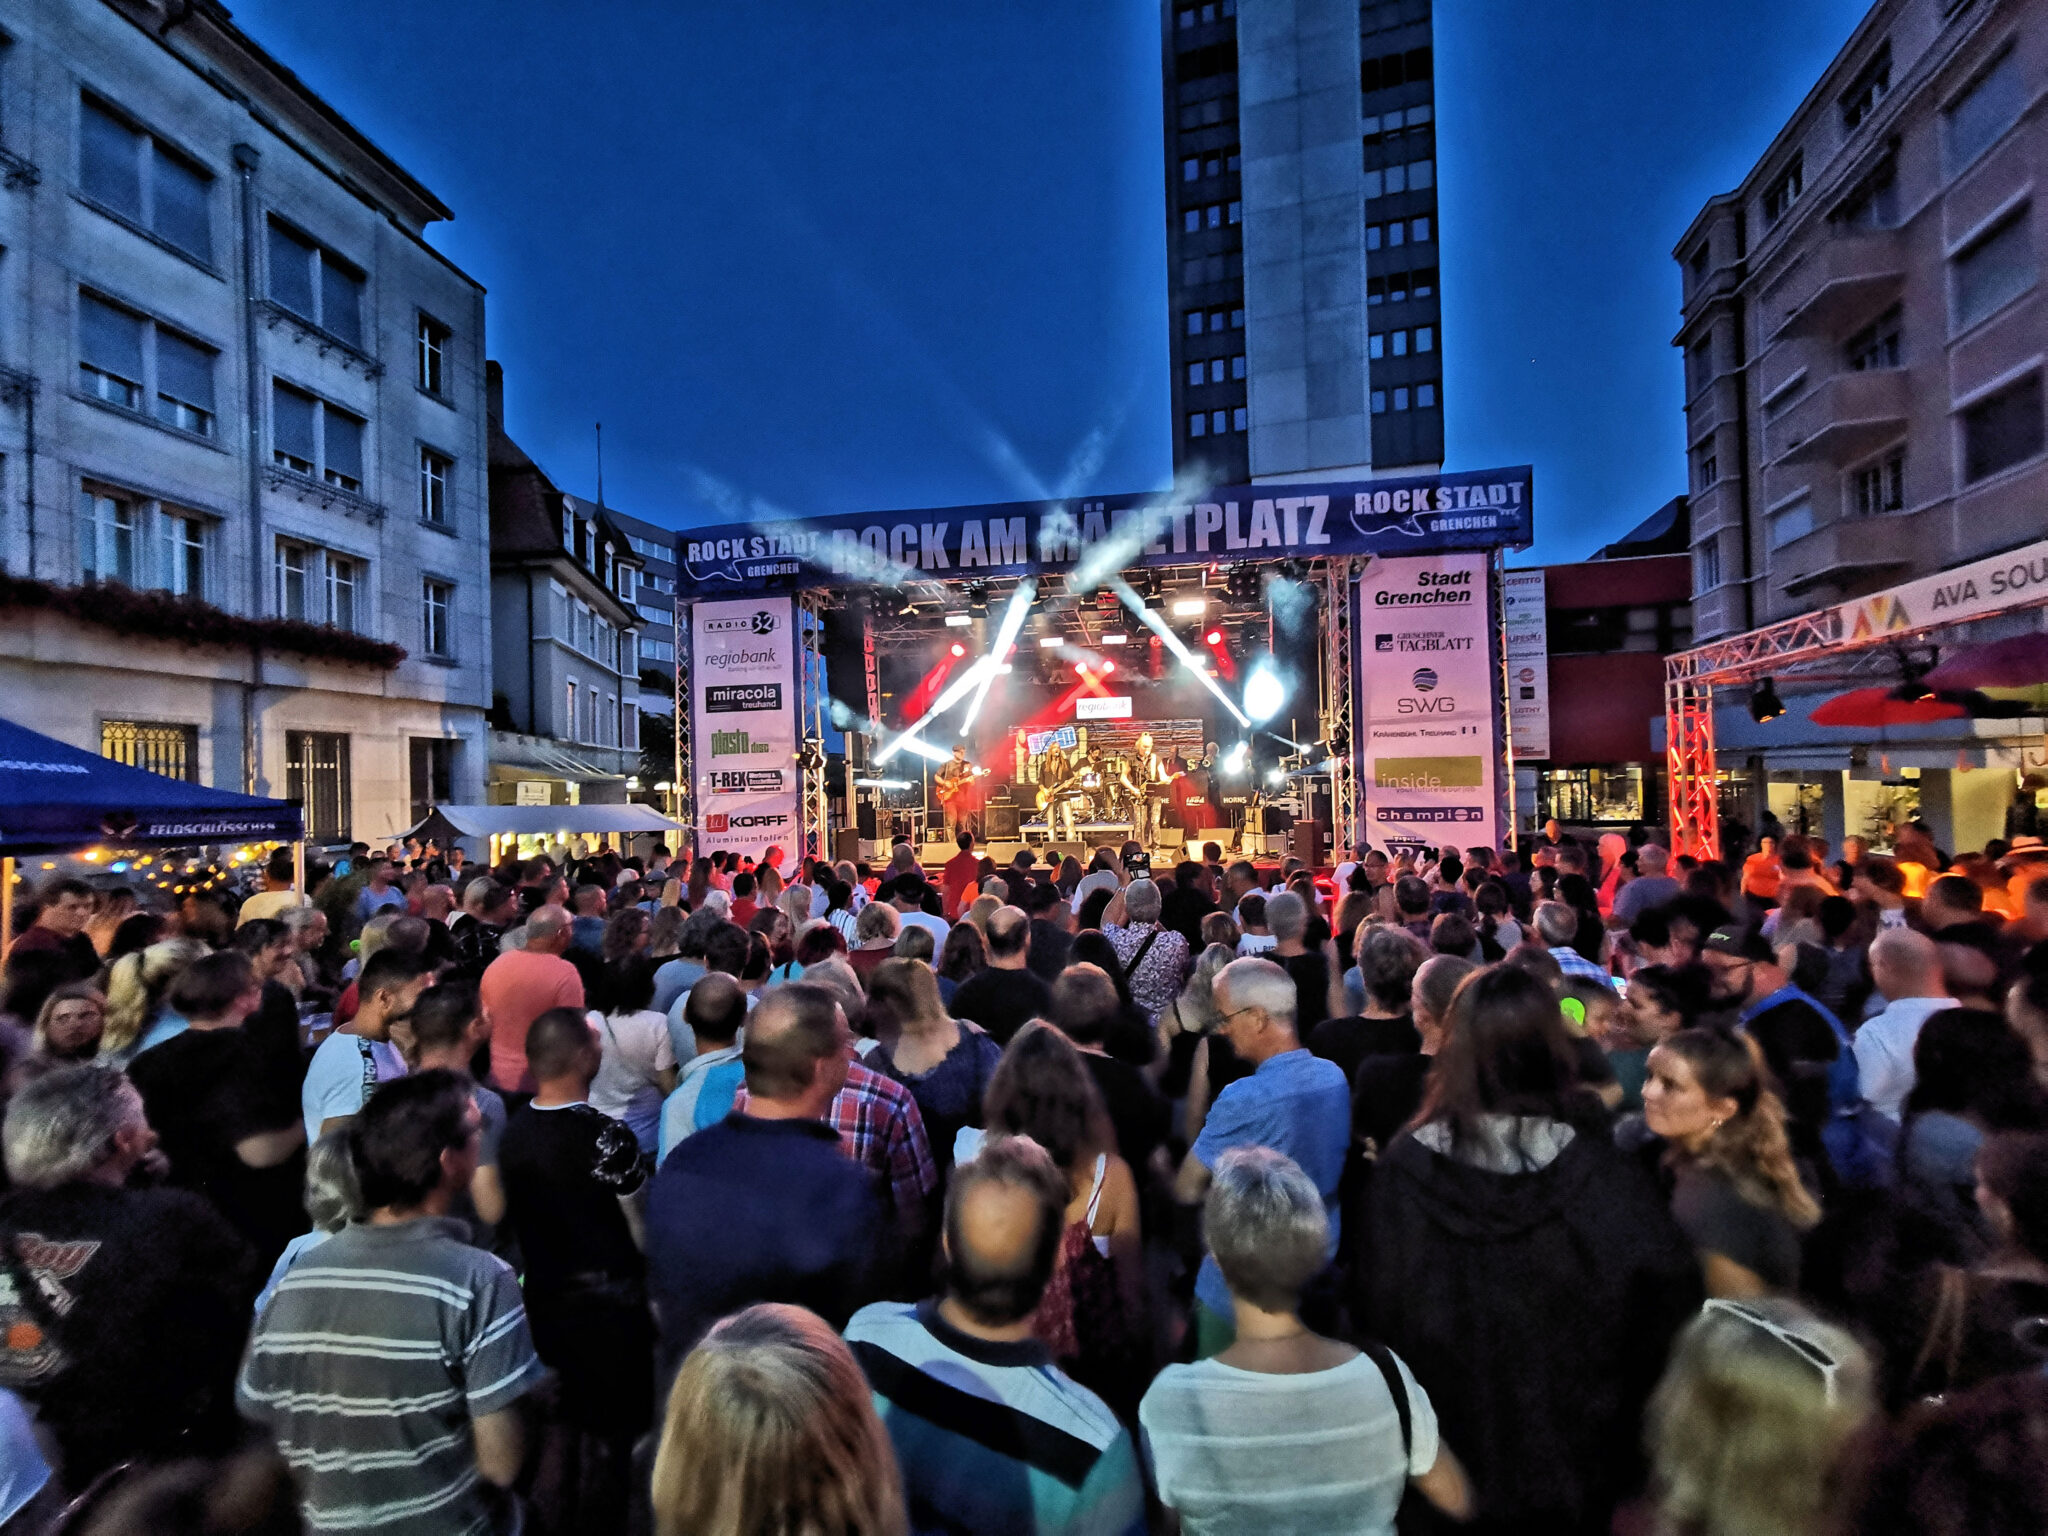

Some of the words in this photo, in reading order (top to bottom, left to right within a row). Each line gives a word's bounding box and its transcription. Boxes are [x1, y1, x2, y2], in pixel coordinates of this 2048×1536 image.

[1355, 488, 1431, 515] ROCK
[1436, 482, 1524, 510] STADT
[1430, 515, 1497, 532] GRENCHEN
[688, 538, 746, 563] ROCK
[751, 531, 820, 557] STADT
[832, 521, 950, 574] ROCK
[959, 517, 1027, 567] AM
[747, 562, 799, 577] GRENCHEN
[1418, 571, 1472, 587] Stadt
[1932, 579, 1979, 611] AVA
[1991, 556, 2048, 596] SOU
[1375, 589, 1471, 605] Grenchen
[708, 620, 747, 630] RADIO
[752, 614, 773, 633] 32
[1397, 637, 1473, 652] TAGBLATT
[705, 648, 776, 669] regiobank
[713, 686, 776, 701] miracola
[742, 700, 776, 709] treuhand
[1078, 700, 1127, 713] regiobk
[1397, 697, 1455, 714] SWG
[710, 771, 747, 787] T-REX
[1382, 771, 1441, 788] inside
[730, 815, 787, 828] KORFF
[706, 835, 789, 844] Aluminiumfolien
